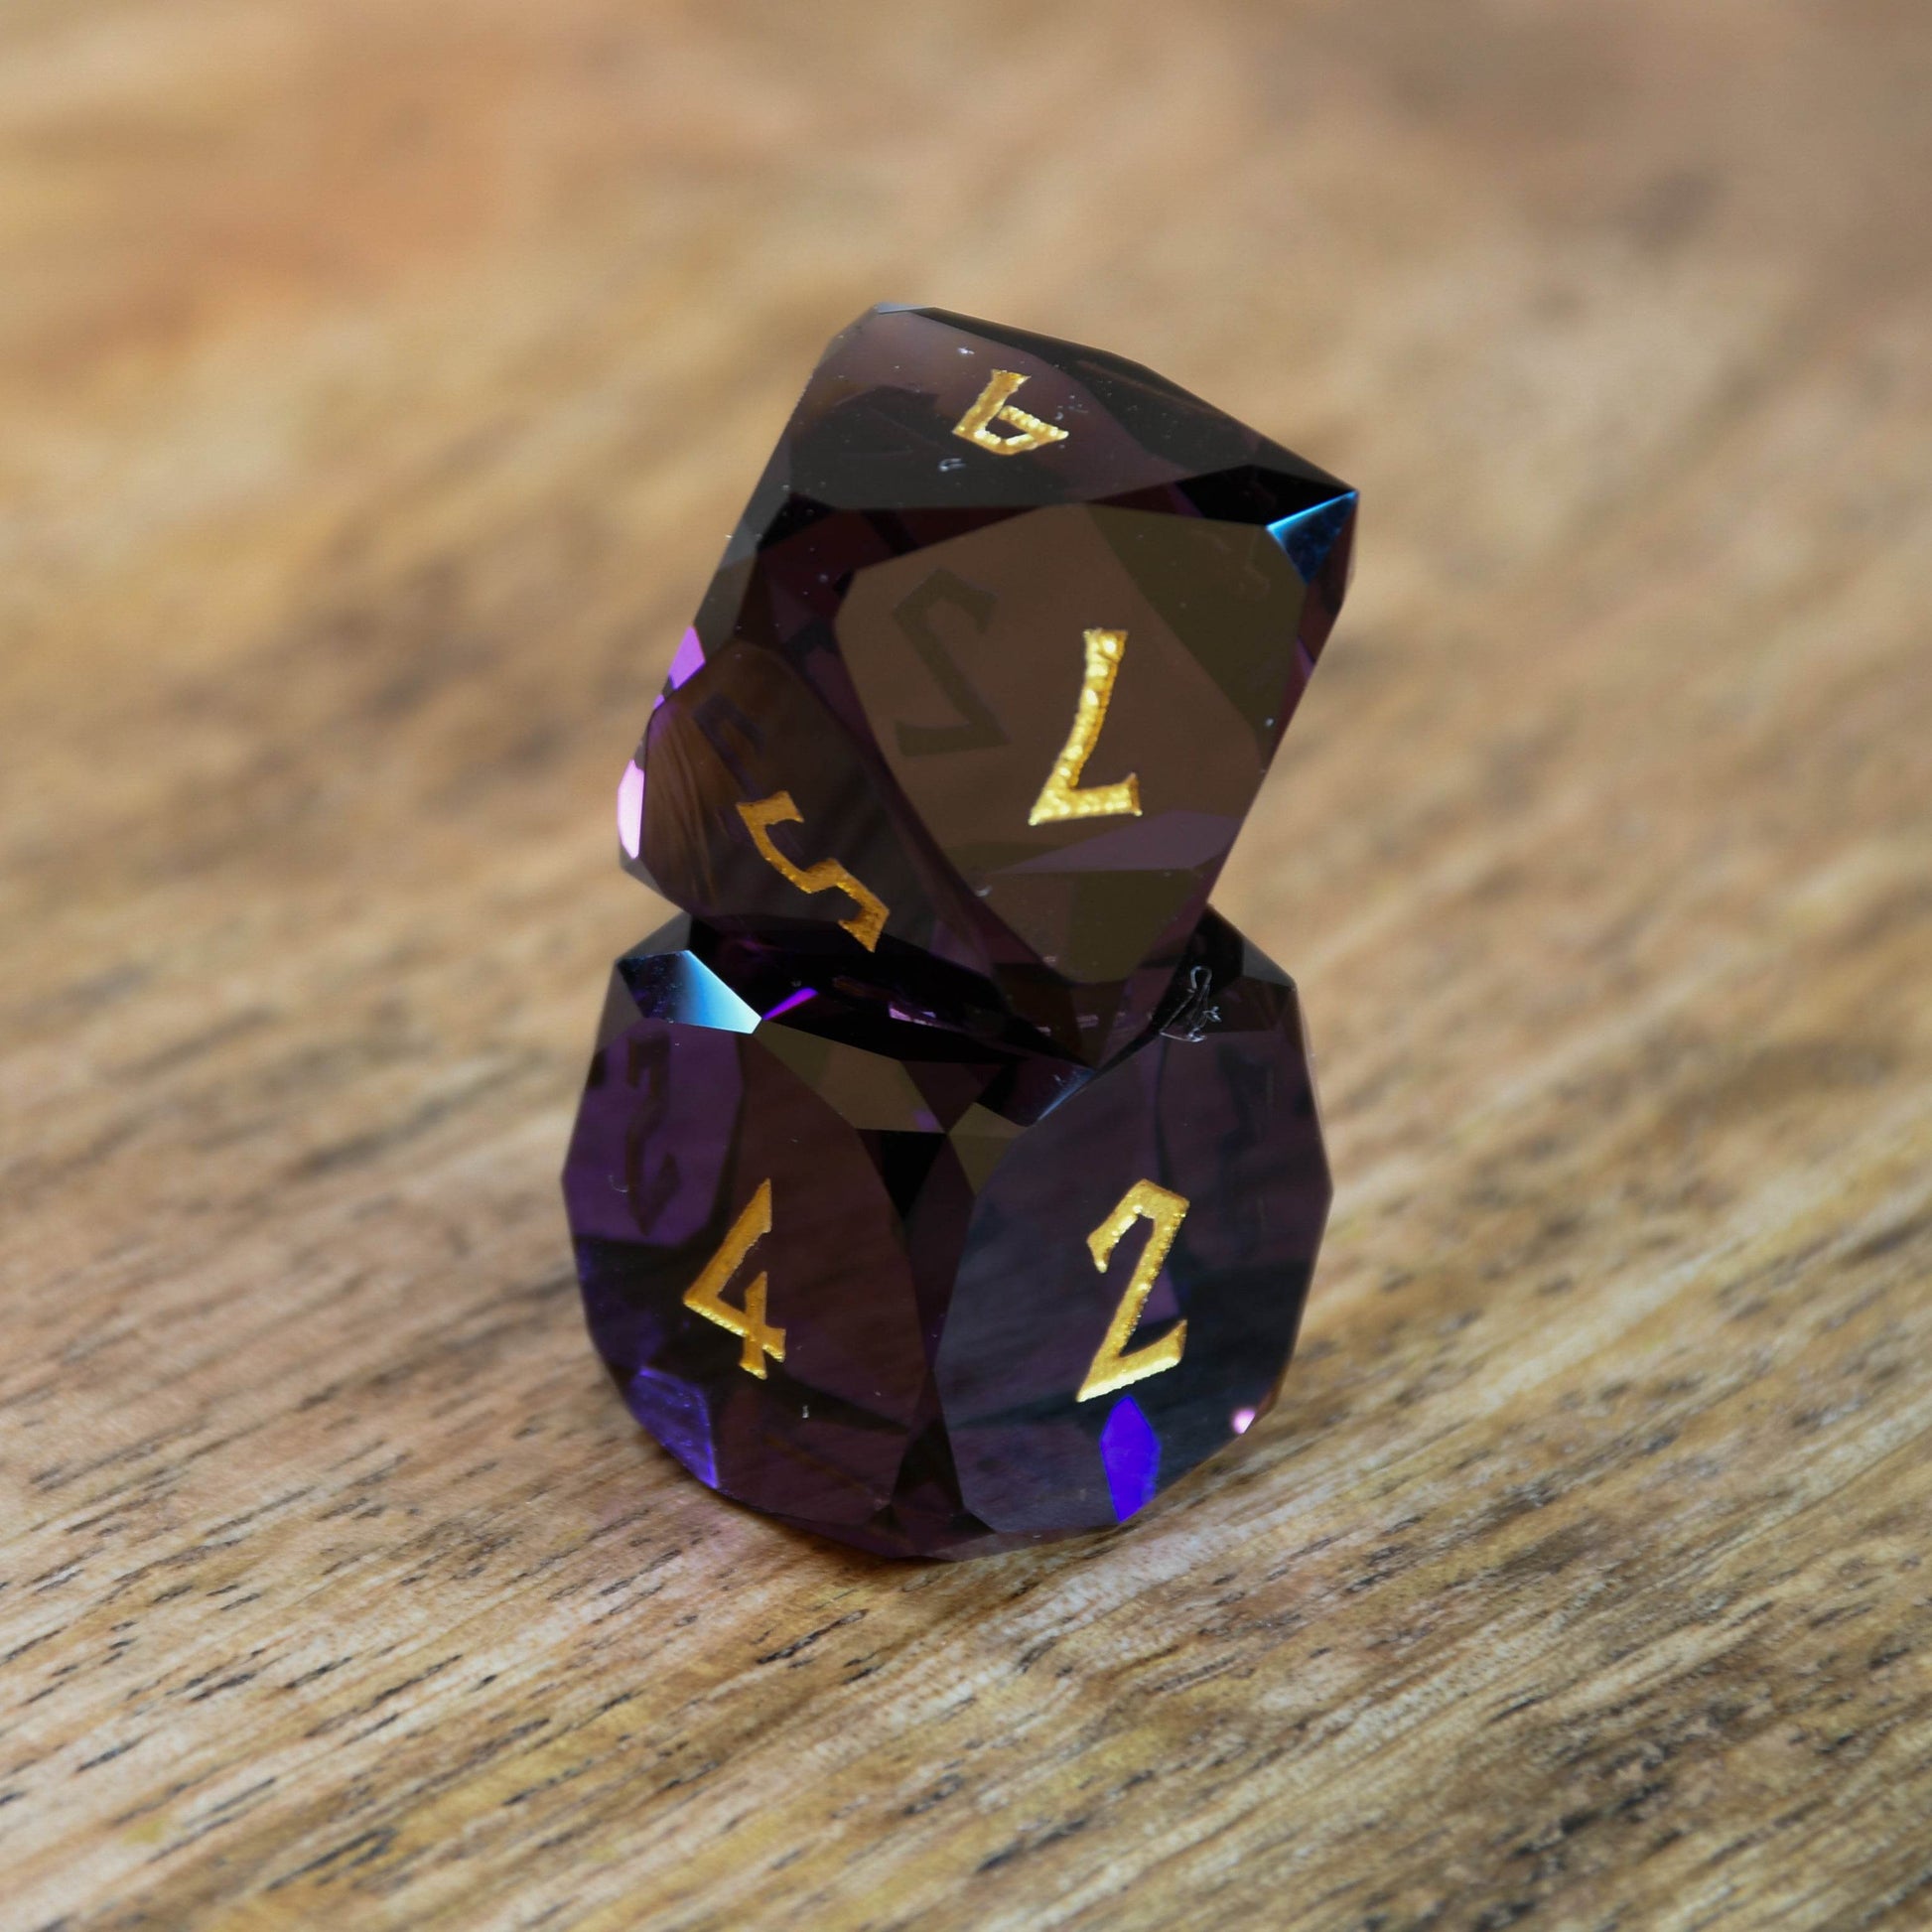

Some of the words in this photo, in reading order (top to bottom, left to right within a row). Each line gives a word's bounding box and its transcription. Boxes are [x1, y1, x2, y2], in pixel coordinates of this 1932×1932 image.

[1028, 627, 1143, 826] 7
[736, 790, 890, 952] 5
[684, 1178, 786, 1380] 4
[1077, 1177, 1190, 1403] 2
